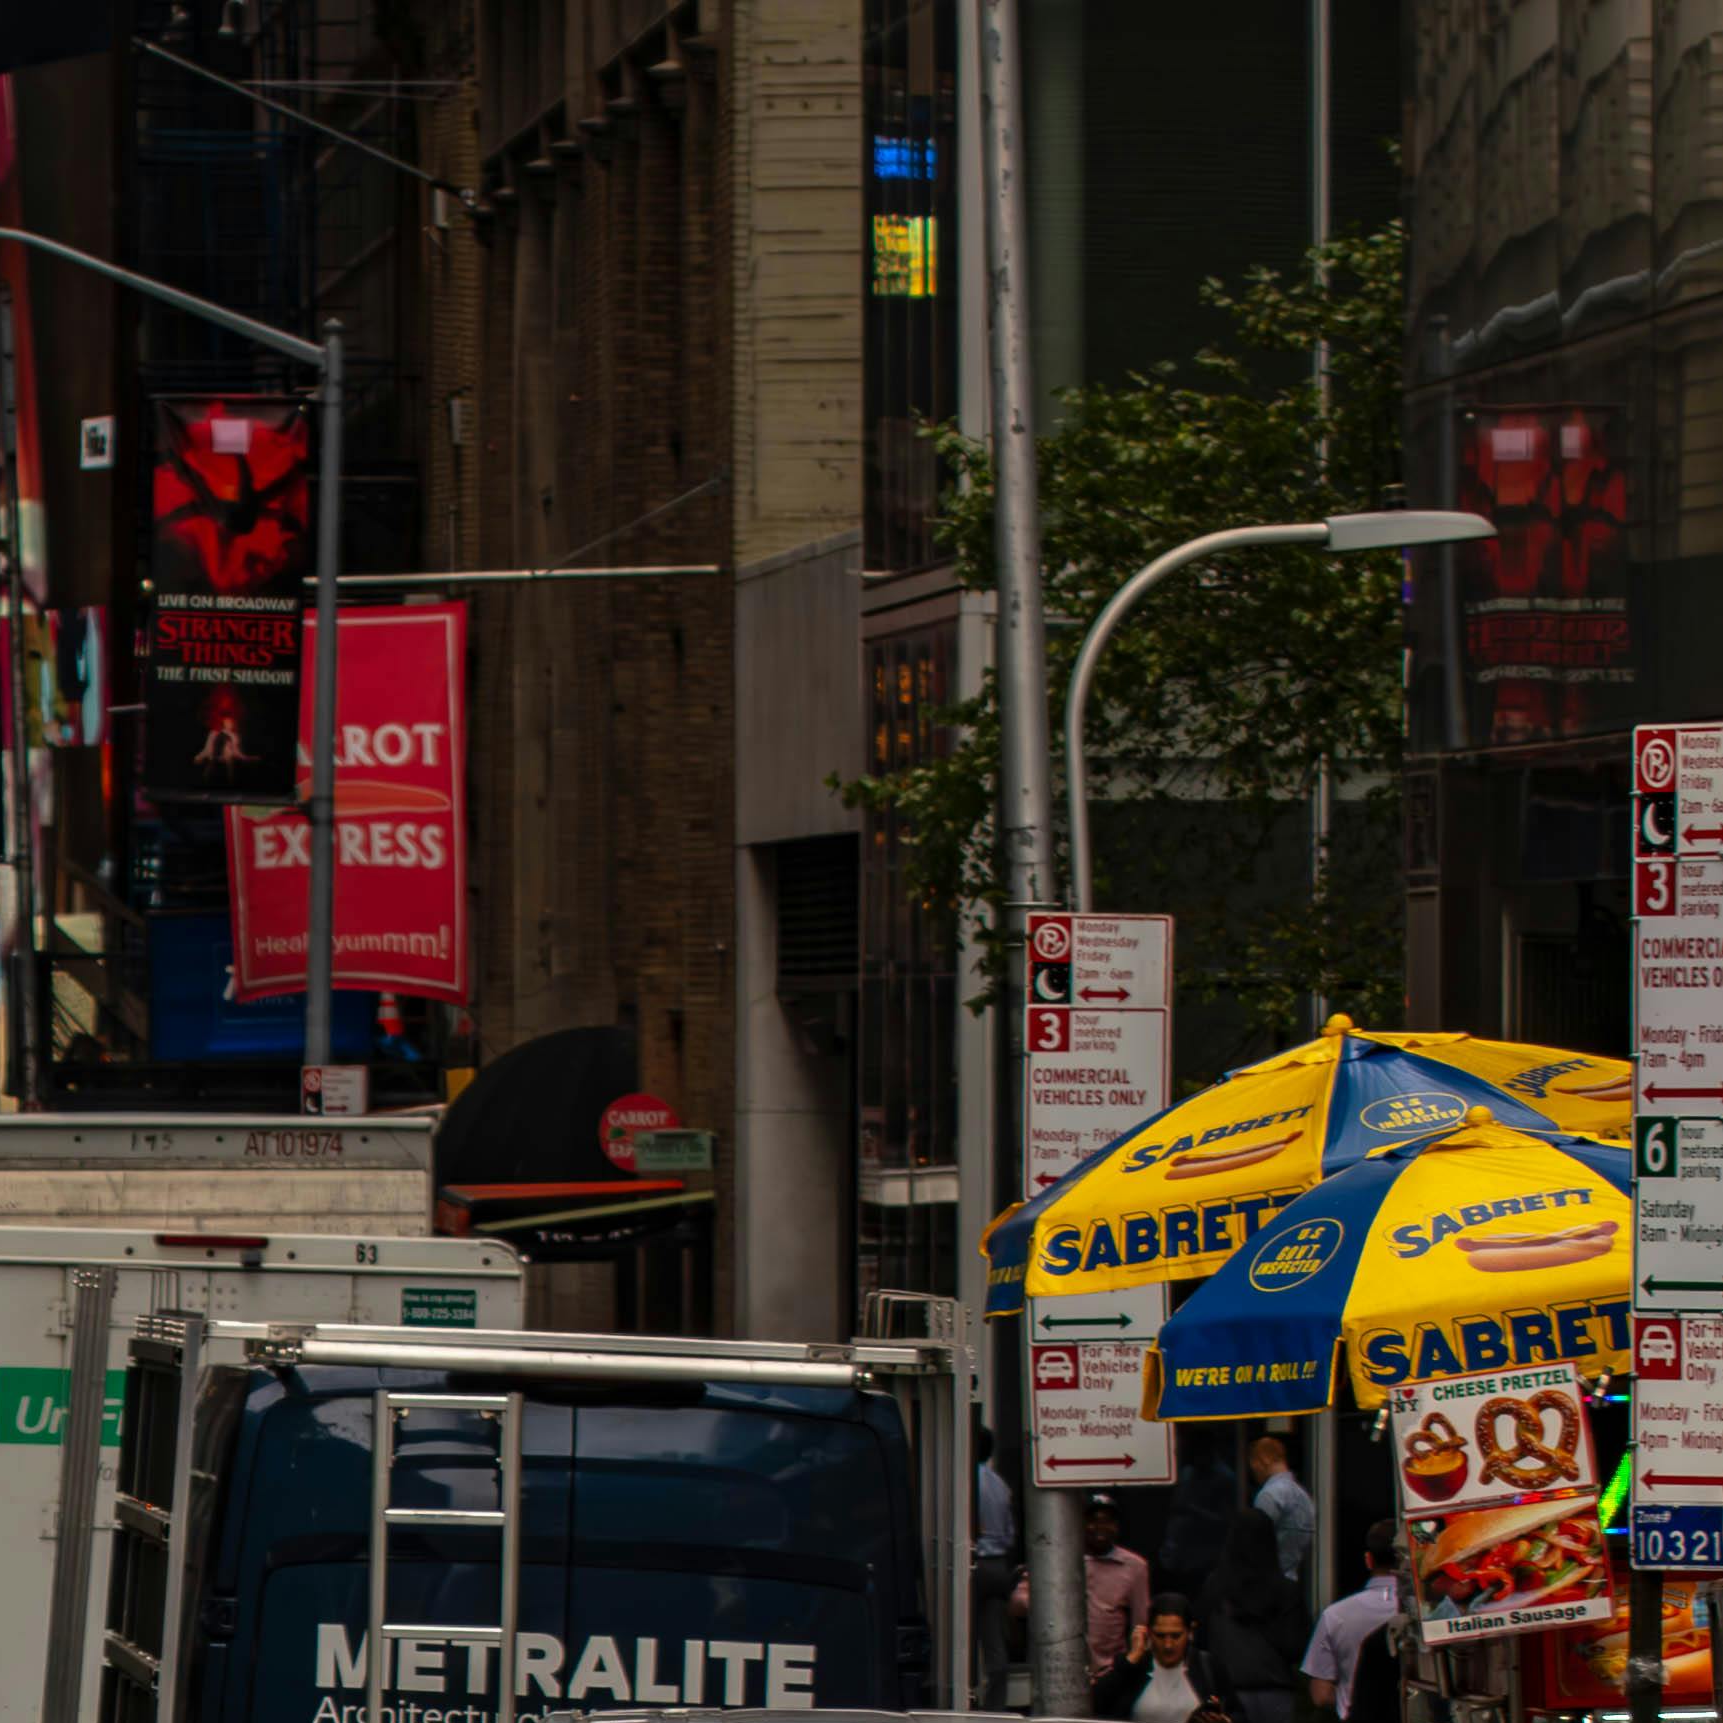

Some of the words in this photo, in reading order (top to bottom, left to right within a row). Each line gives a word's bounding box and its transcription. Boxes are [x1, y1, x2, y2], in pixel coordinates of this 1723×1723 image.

[157, 593, 187, 608] LIVE
[189, 594, 213, 609] ON
[215, 594, 297, 610] BROADWAY
[156, 616, 297, 648] STRANGER
[179, 641, 275, 666] THINGS
[156, 666, 184, 681] THE
[189, 667, 231, 682] FIRST
[233, 669, 295, 685] SHADOW
[1680, 733, 1721, 751] Monday
[1680, 756, 1723, 771] Wednes
[1680, 774, 1713, 791] Friday
[1680, 800, 1704, 814] 2am
[1712, 799, 1723, 813] 6a
[252, 822, 447, 870] EXRESS
[1681, 865, 1706, 878] hour
[1646, 863, 1670, 911] 3
[1681, 900, 1720, 919] parking
[1076, 919, 1120, 934] Monday
[1076, 934, 1140, 950] Wednesday
[1641, 936, 1723, 960] COMMERCIA
[1076, 950, 1112, 964] Friday
[1076, 967, 1100, 980] 2am
[1108, 967, 1134, 980] 6am
[1641, 966, 1709, 988] VEHICLES
[1074, 1013, 1100, 1026] hour
[1037, 1012, 1062, 1051] 3
[1074, 1026, 1122, 1039] metered
[1640, 1025, 1688, 1048] Monday
[1699, 1025, 1723, 1043] Frid
[1074, 1039, 1117, 1055] parking
[1641, 1050, 1668, 1067] 7am
[1679, 1050, 1706, 1072] 4pm
[1032, 1067, 1131, 1086] COMMERCIAL
[1032, 1089, 1104, 1106] VEHICLES
[1108, 1089, 1147, 1106] ONLY
[1031, 1127, 1081, 1145] Monday
[1092, 1128, 1125, 1142] Frid
[1121, 1103, 1315, 1175] SABRETT
[1681, 1126, 1705, 1140] hour
[245, 1131, 344, 1157] AT101974
[1033, 1145, 1061, 1159] 7am
[1644, 1121, 1668, 1174] 6
[1680, 1164, 1721, 1182] parking
[1640, 1199, 1696, 1222] Saturday
[1386, 1187, 1596, 1259] SABRETT
[1640, 1224, 1668, 1243] 8am
[1680, 1224, 1723, 1247] Midnig
[355, 1243, 379, 1265] 63
[1254, 1258, 1322, 1276] INSPECTED
[1360, 1296, 1632, 1387] SABRET
[1686, 1341, 1723, 1360] Vehic
[1082, 1359, 1139, 1374] Vehicles
[1174, 1363, 1231, 1388] WE'RE
[1234, 1364, 1252, 1385] ON
[1255, 1365, 1265, 1383] A
[1268, 1361, 1299, 1383] ROLL
[1686, 1363, 1716, 1388] Only
[1083, 1375, 1114, 1391] Only
[1432, 1383, 1498, 1402] CHEESE
[1501, 1368, 1573, 1394] PRETZEL
[1039, 1405, 1088, 1420] Monday
[1099, 1404, 1138, 1420] Friday
[1393, 1398, 1419, 1414] NY
[1640, 1402, 1689, 1425] Monday
[1703, 1402, 1723, 1422] Fri
[1040, 1424, 1068, 1439] 4pm
[1079, 1422, 1134, 1439] Midnight
[1640, 1432, 1669, 1452] 4pm
[1681, 1431, 1723, 1454] Midnig
[1636, 1510, 1672, 1525] Zone#
[1637, 1529, 1722, 1562] 10321
[1447, 1613, 1505, 1634] Italian
[1509, 1603, 1587, 1626] Sausage
[315, 1622, 818, 1709] METRALITE
